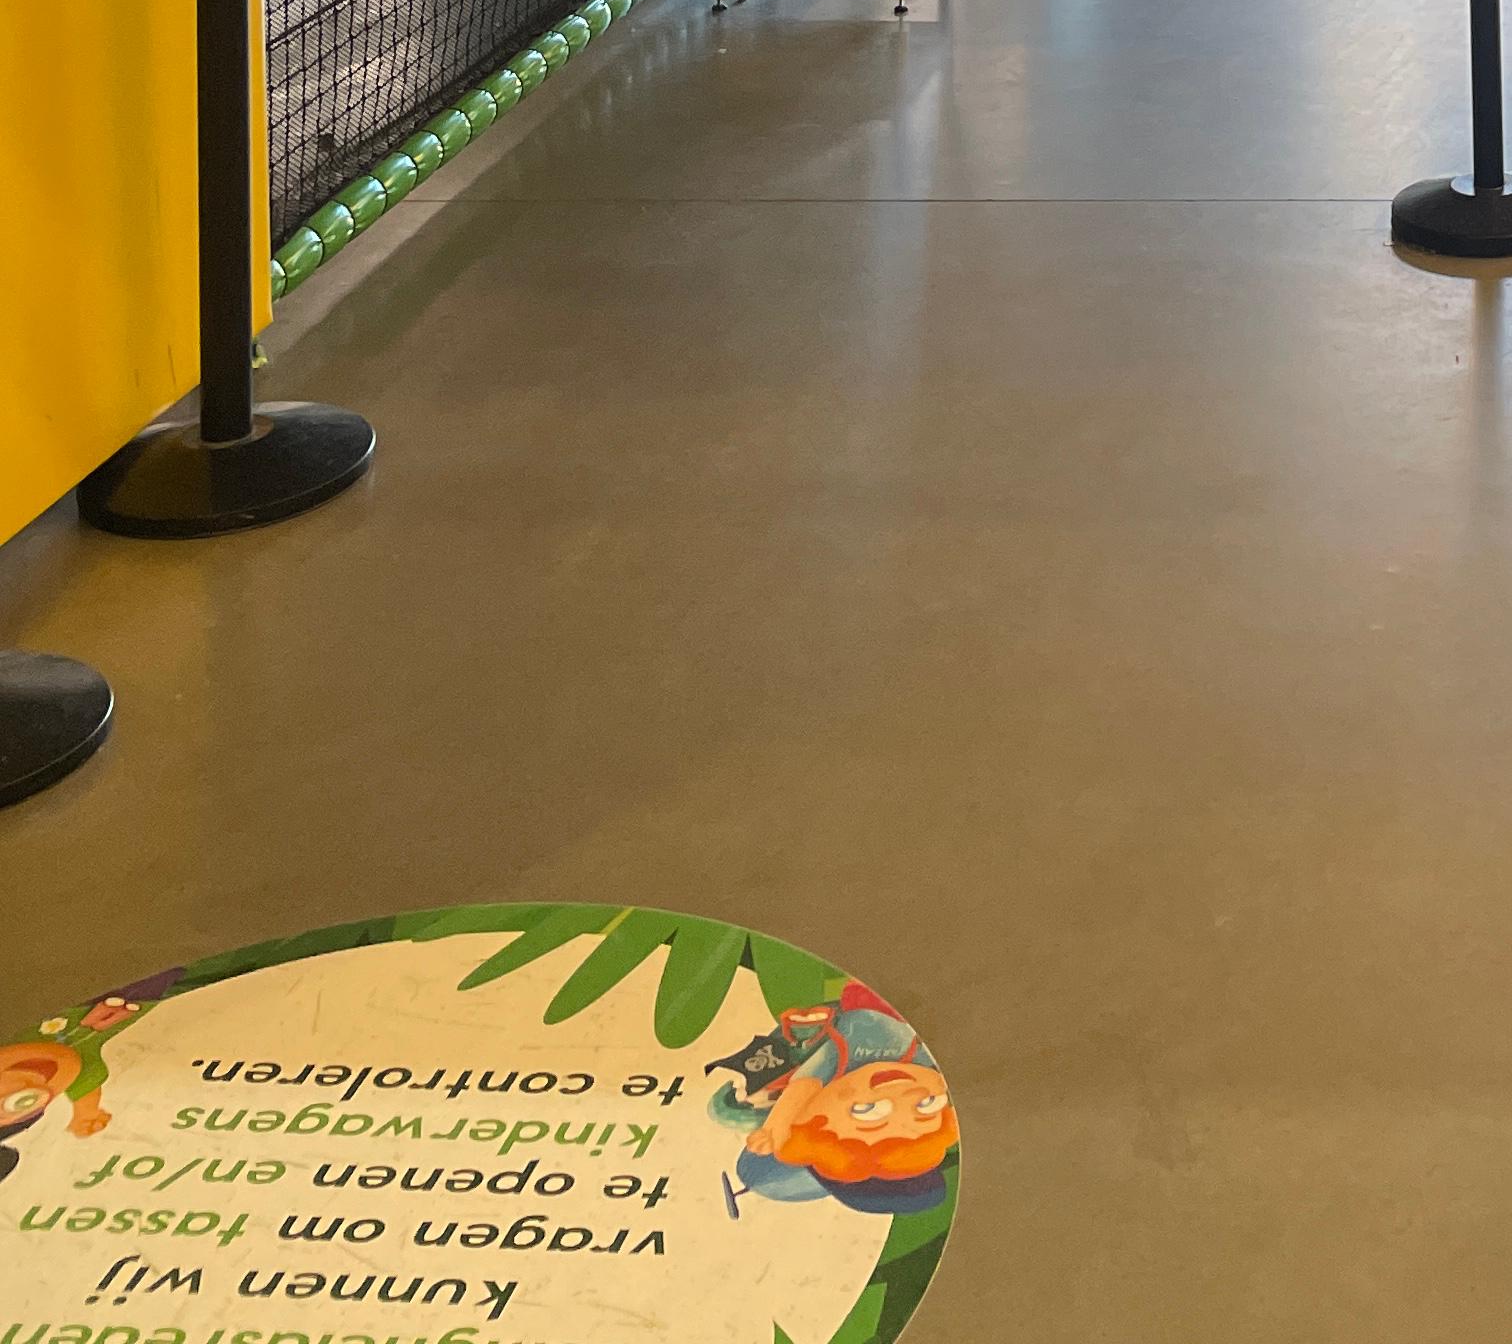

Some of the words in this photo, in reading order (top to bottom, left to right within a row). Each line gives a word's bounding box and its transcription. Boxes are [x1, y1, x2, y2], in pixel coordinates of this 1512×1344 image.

[191, 1059, 596, 1102] controleren.
[621, 1073, 685, 1106] te
[171, 1102, 660, 1159] kinderwagens
[73, 1154, 286, 1192] en/of
[312, 1159, 576, 1197] openen
[603, 1174, 669, 1210] te
[18, 1206, 250, 1247] tassen
[278, 1215, 386, 1244] om
[413, 1214, 666, 1255] vragen
[84, 1254, 203, 1306] wij
[238, 1270, 519, 1321] kunnen
